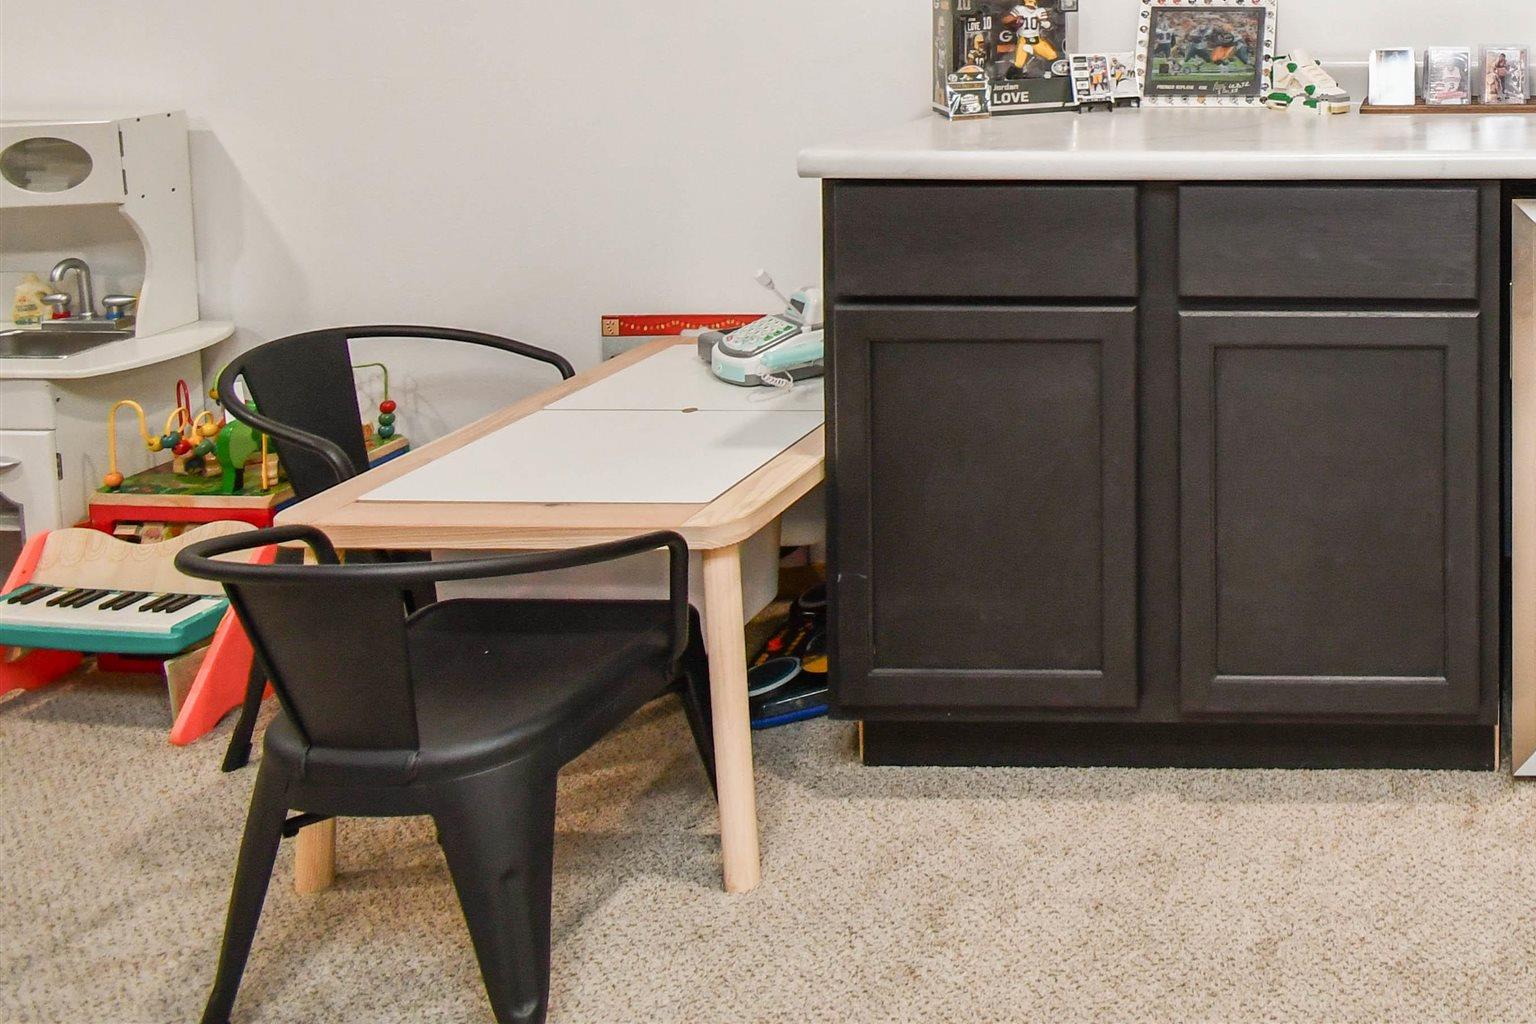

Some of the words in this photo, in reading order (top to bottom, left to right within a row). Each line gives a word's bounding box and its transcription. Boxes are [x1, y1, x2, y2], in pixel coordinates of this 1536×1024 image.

[967, 21, 981, 31] LOVE
[982, 17, 993, 30] 10
[1023, 17, 1039, 30] 10
[993, 83, 1019, 92] Jordan
[993, 91, 1030, 104] LOVE
